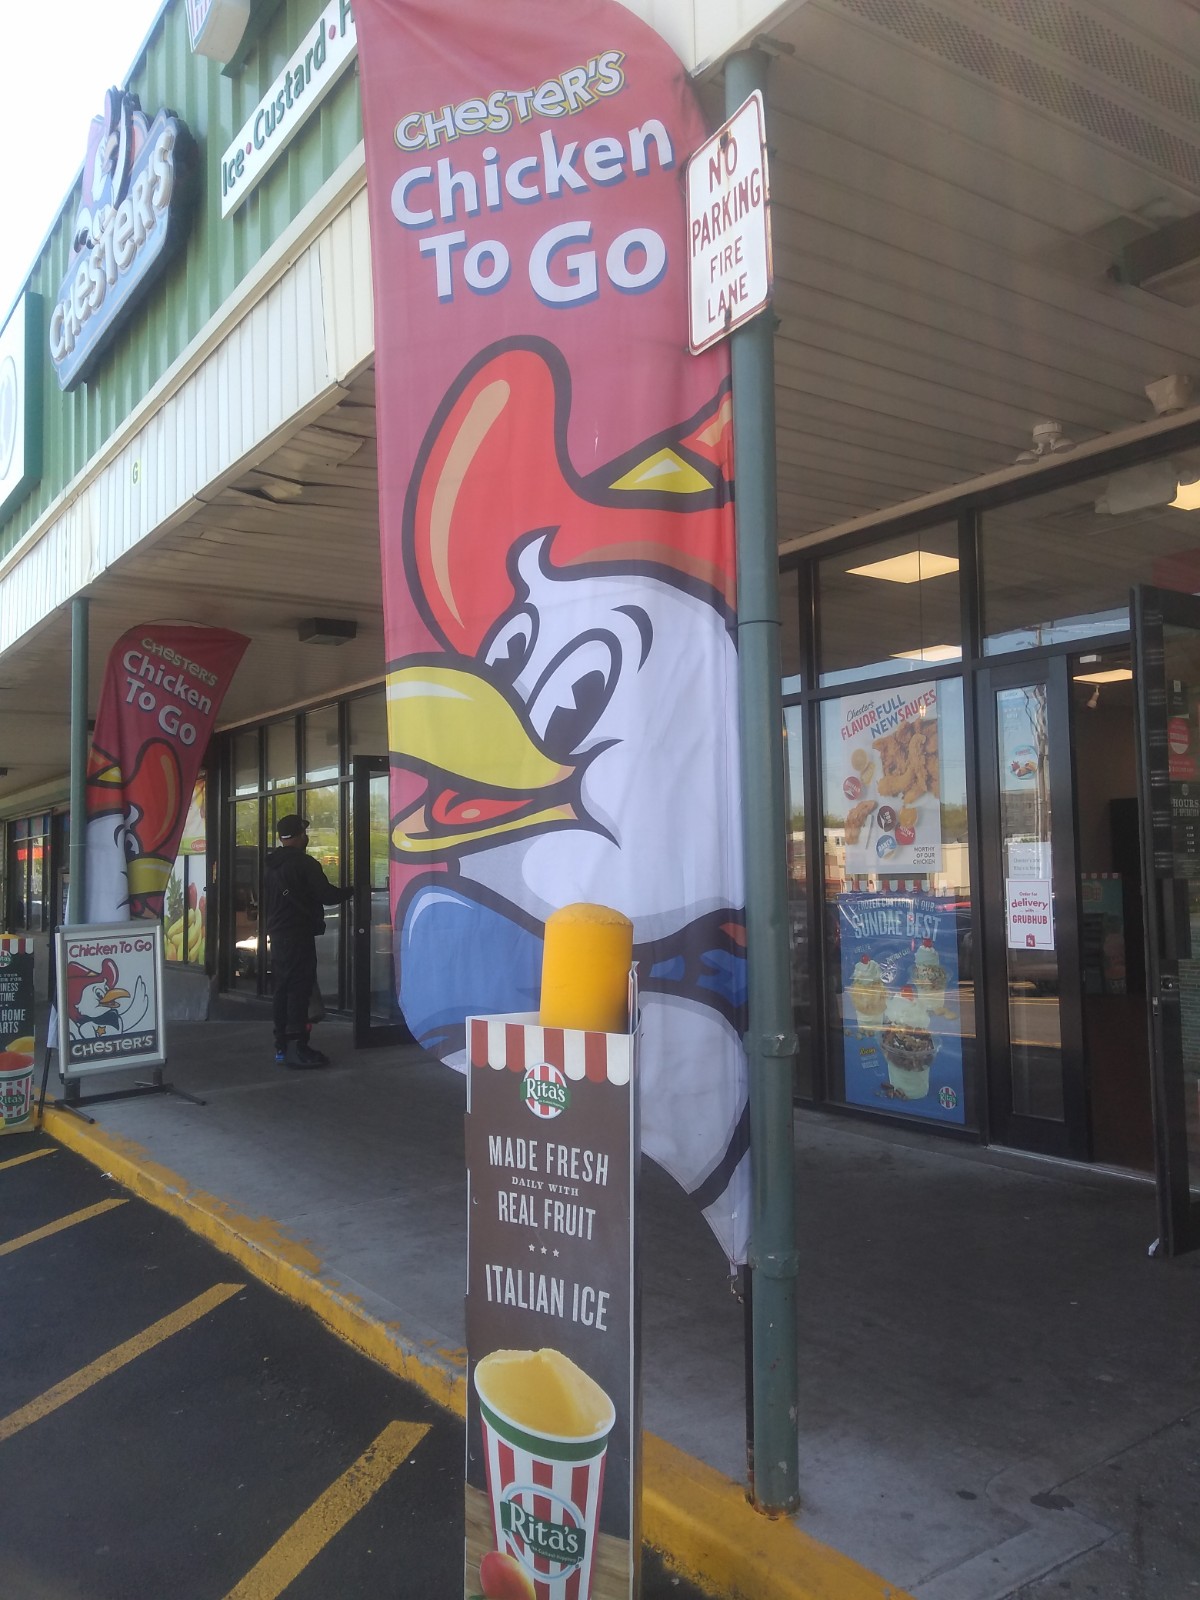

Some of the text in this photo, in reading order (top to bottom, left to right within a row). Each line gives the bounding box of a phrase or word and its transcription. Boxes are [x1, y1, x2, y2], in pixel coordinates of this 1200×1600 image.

[223, 19, 325, 197] Ice Custard
[390, 119, 674, 226] Chicken
[709, 136, 738, 193] NO
[692, 168, 760, 257] PARKING
[419, 221, 667, 304] To Go
[710, 235, 743, 284] FIRE
[708, 272, 748, 324] LANE
[132, 462, 139, 484] G
[123, 651, 212, 715] Chicken
[126, 677, 196, 745] To Go
[852, 910, 942, 942] SUNDAE BEST
[1011, 898, 1048, 910] delivery
[1012, 915, 1048, 925] GRUBHUB
[69, 940, 153, 958] Chicken To Go
[1, 1009, 26, 1021] HOME
[527, 1078, 566, 1103] Rita's
[488, 1135, 609, 1187] MADE FRESH
[512, 1176, 579, 1197] DAILY WITH
[498, 1190, 596, 1241] REAL FRUIT
[485, 1264, 610, 1332] ITALIAN ICE
[510, 1502, 579, 1553] Rita's
